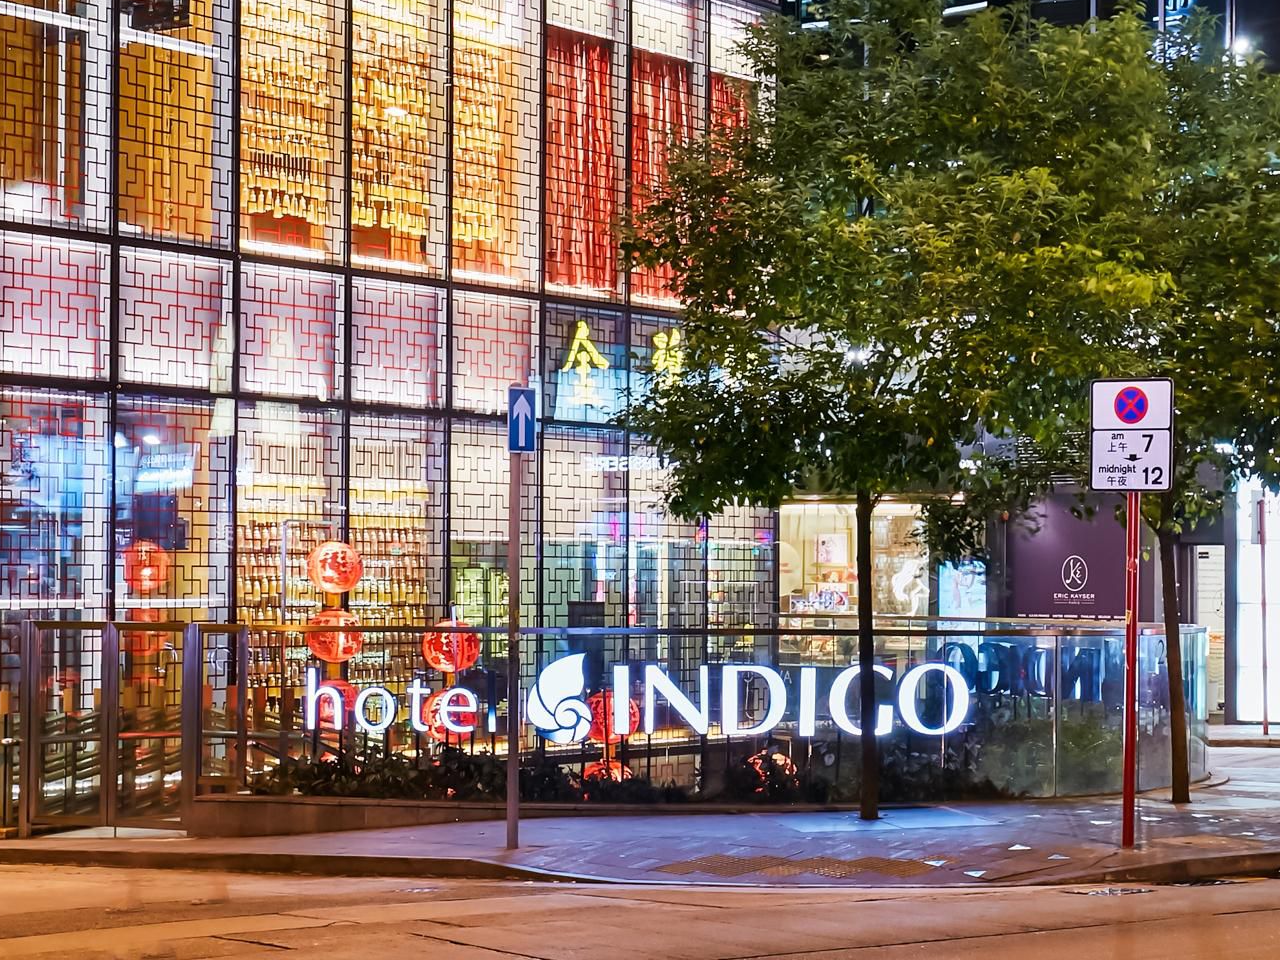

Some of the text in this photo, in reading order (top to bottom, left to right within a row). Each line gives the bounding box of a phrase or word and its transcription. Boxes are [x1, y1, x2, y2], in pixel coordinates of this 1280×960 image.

[1107, 441, 1128, 453] 上午
[1111, 432, 1154, 452] am 7
[1098, 464, 1163, 485] midnight 12
[1106, 475, 1128, 487] 午夜
[306, 663, 970, 738] hotel INDIGO
